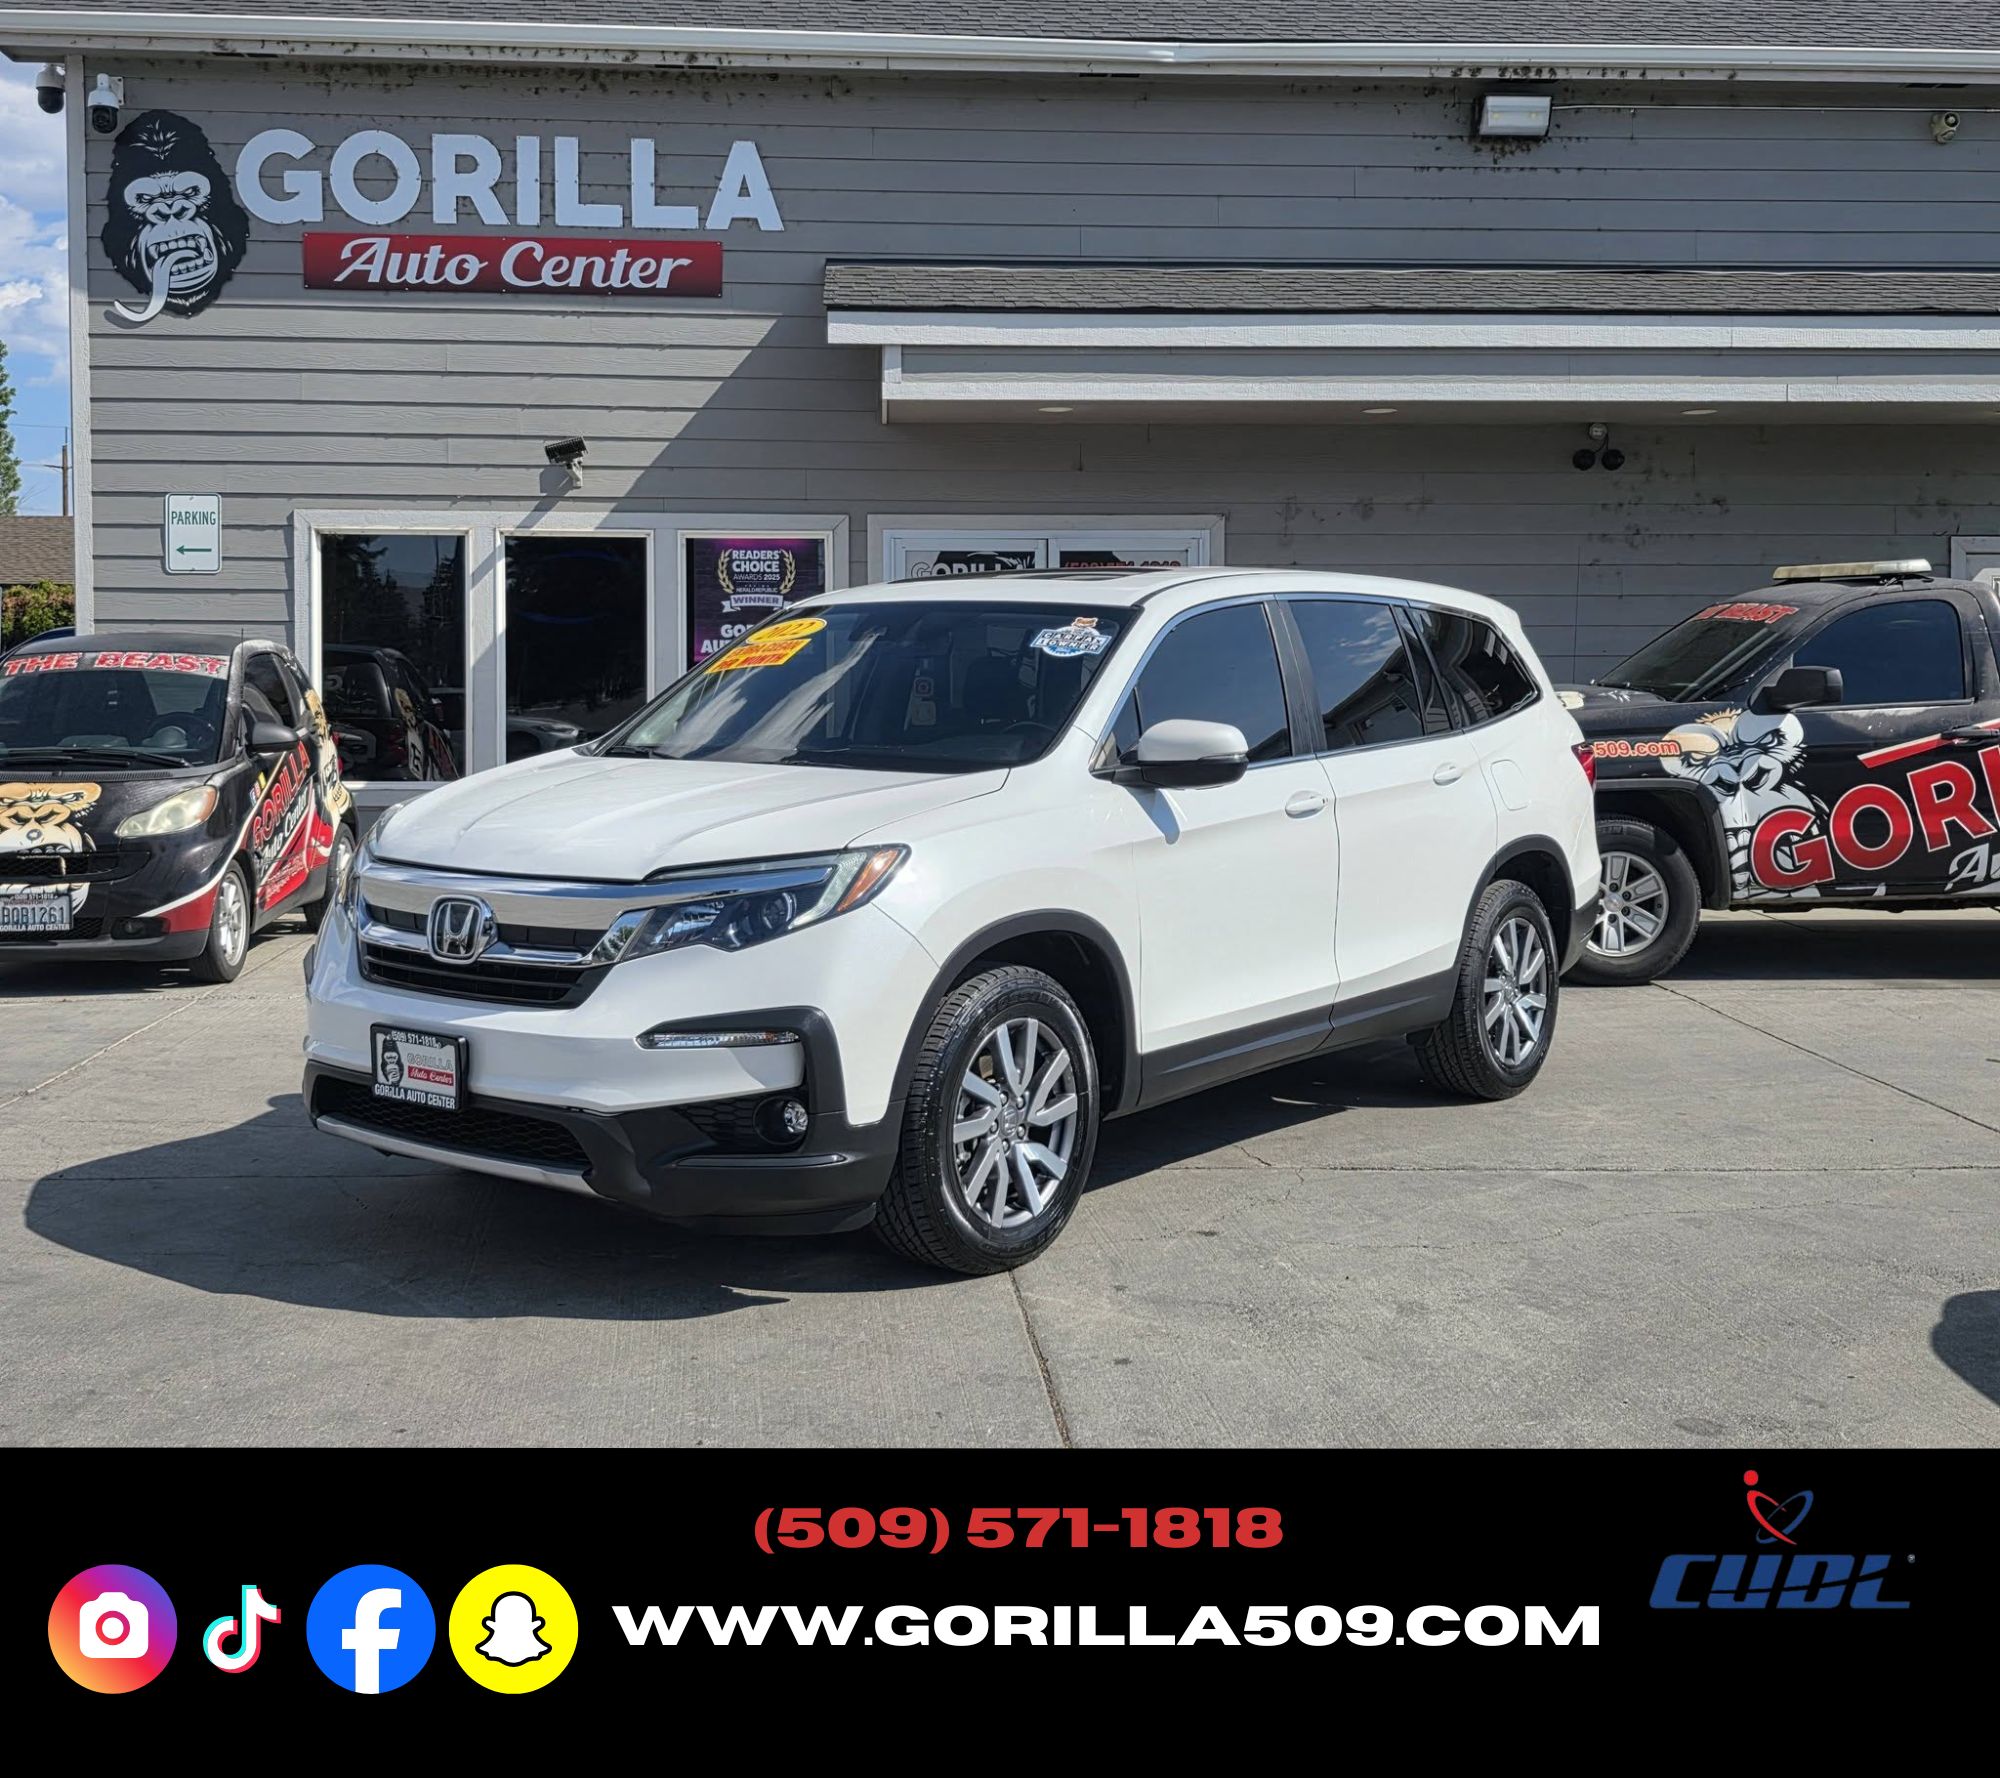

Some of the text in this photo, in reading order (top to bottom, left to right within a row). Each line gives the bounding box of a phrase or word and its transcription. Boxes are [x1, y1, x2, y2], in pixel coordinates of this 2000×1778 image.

[235, 128, 784, 231] GORILLA
[333, 236, 693, 289] Auto Center
[171, 511, 216, 525] PARKING
[732, 550, 781, 560] READERS'
[732, 561, 780, 572] CHOICE
[763, 573, 780, 581] 2025
[732, 596, 780, 604] WINNER
[4, 651, 228, 676] THE BEAST
[252, 740, 311, 849] GORILLA
[374, 1083, 455, 1110] GORILLA AUTO CENTER
